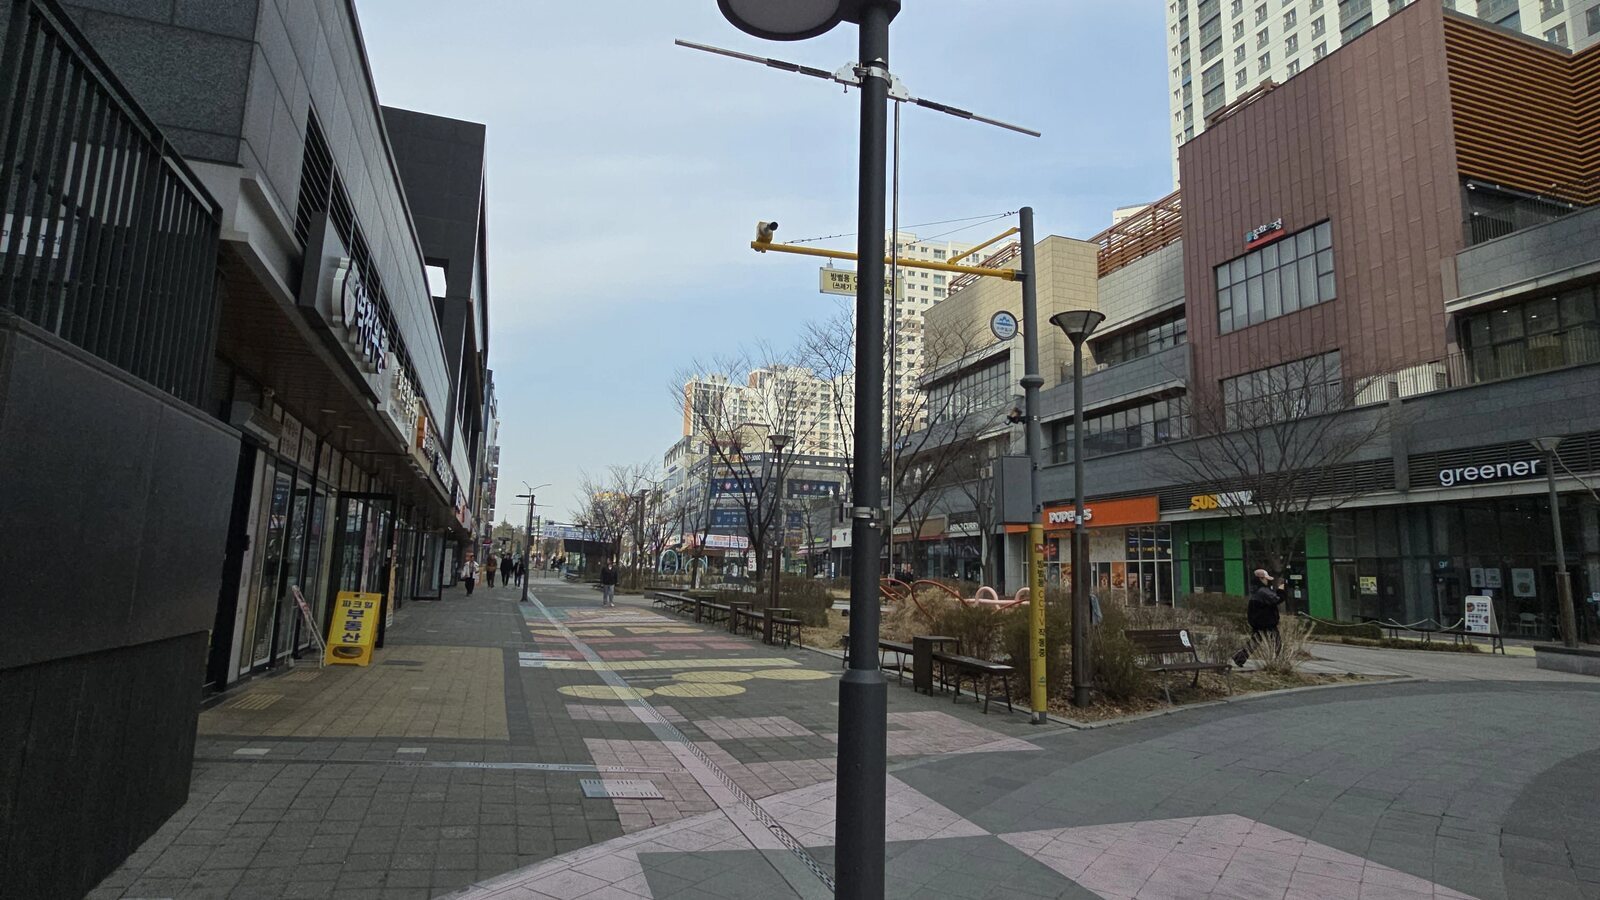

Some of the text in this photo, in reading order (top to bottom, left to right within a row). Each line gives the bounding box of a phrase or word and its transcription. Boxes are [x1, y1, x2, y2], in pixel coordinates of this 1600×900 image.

[830, 273, 850, 283] 방범용
[1439, 459, 1540, 487] greener
[1038, 590, 1046, 626] CCTV
[342, 609, 365, 643] 부동산
